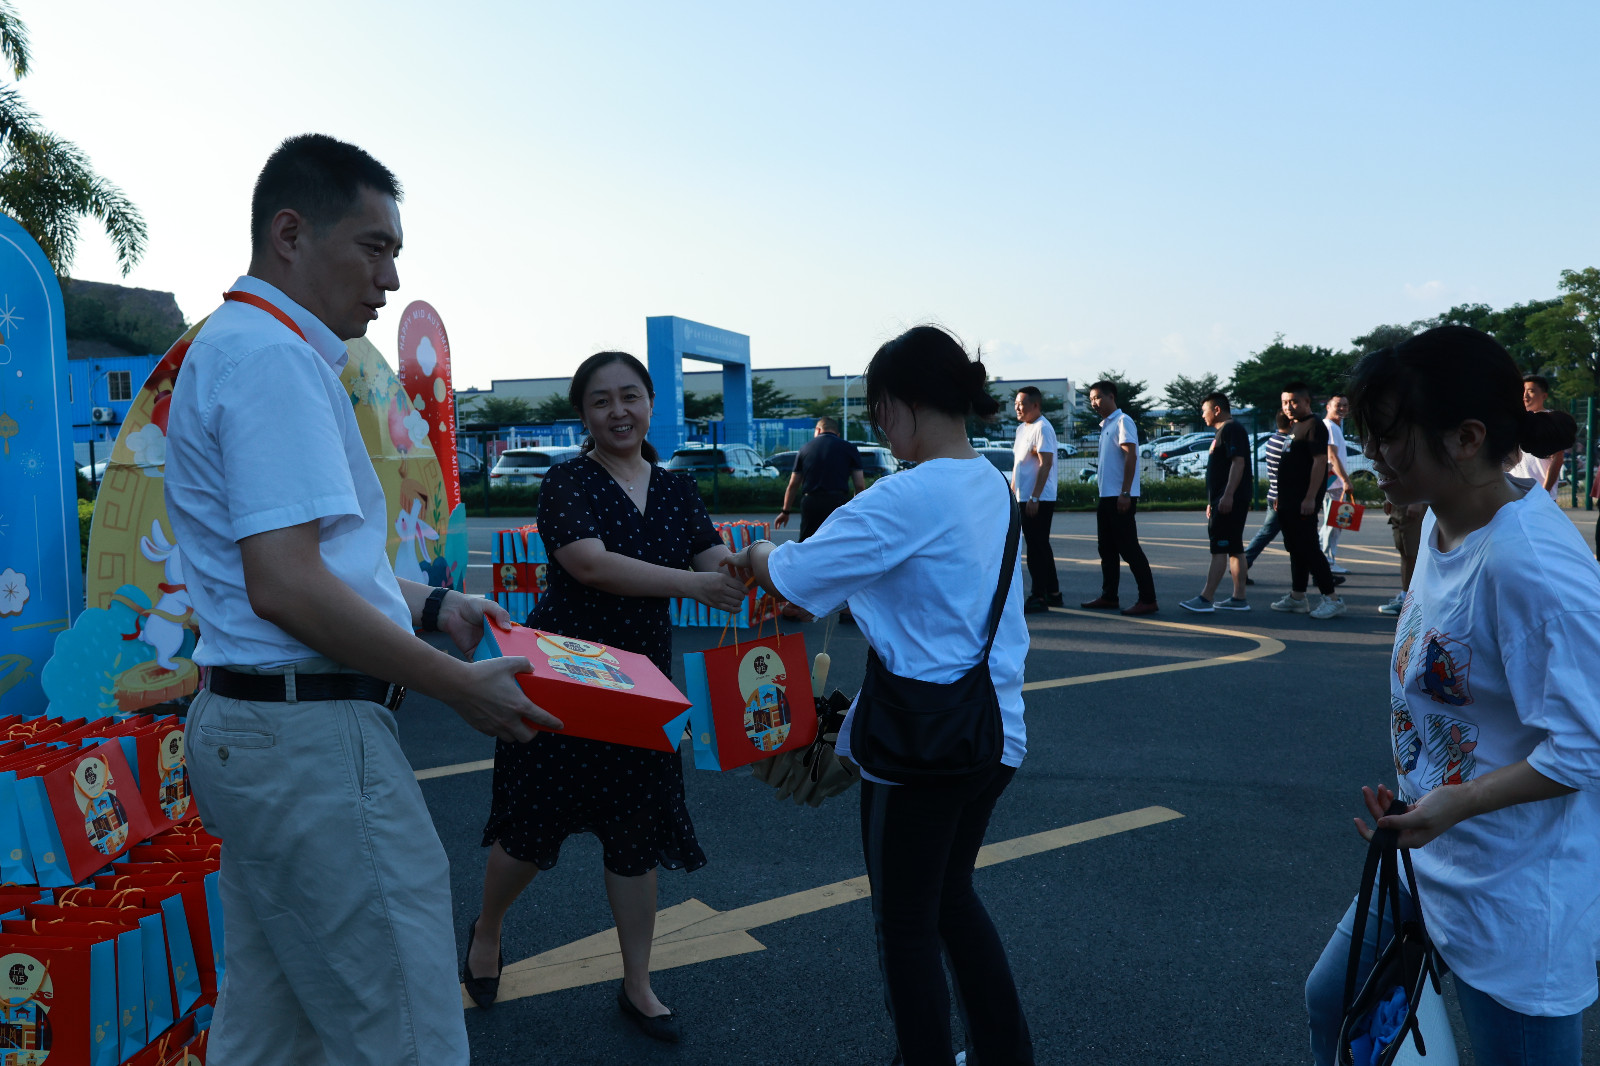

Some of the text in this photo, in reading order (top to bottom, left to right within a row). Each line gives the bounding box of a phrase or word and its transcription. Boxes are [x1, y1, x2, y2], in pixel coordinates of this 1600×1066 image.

[412, 309, 425, 320] MID
[427, 312, 449, 353] AUTUMN
[400, 316, 412, 350] HAPPY
[445, 357, 453, 410] FESTIVAL
[448, 415, 456, 451] HAPPY
